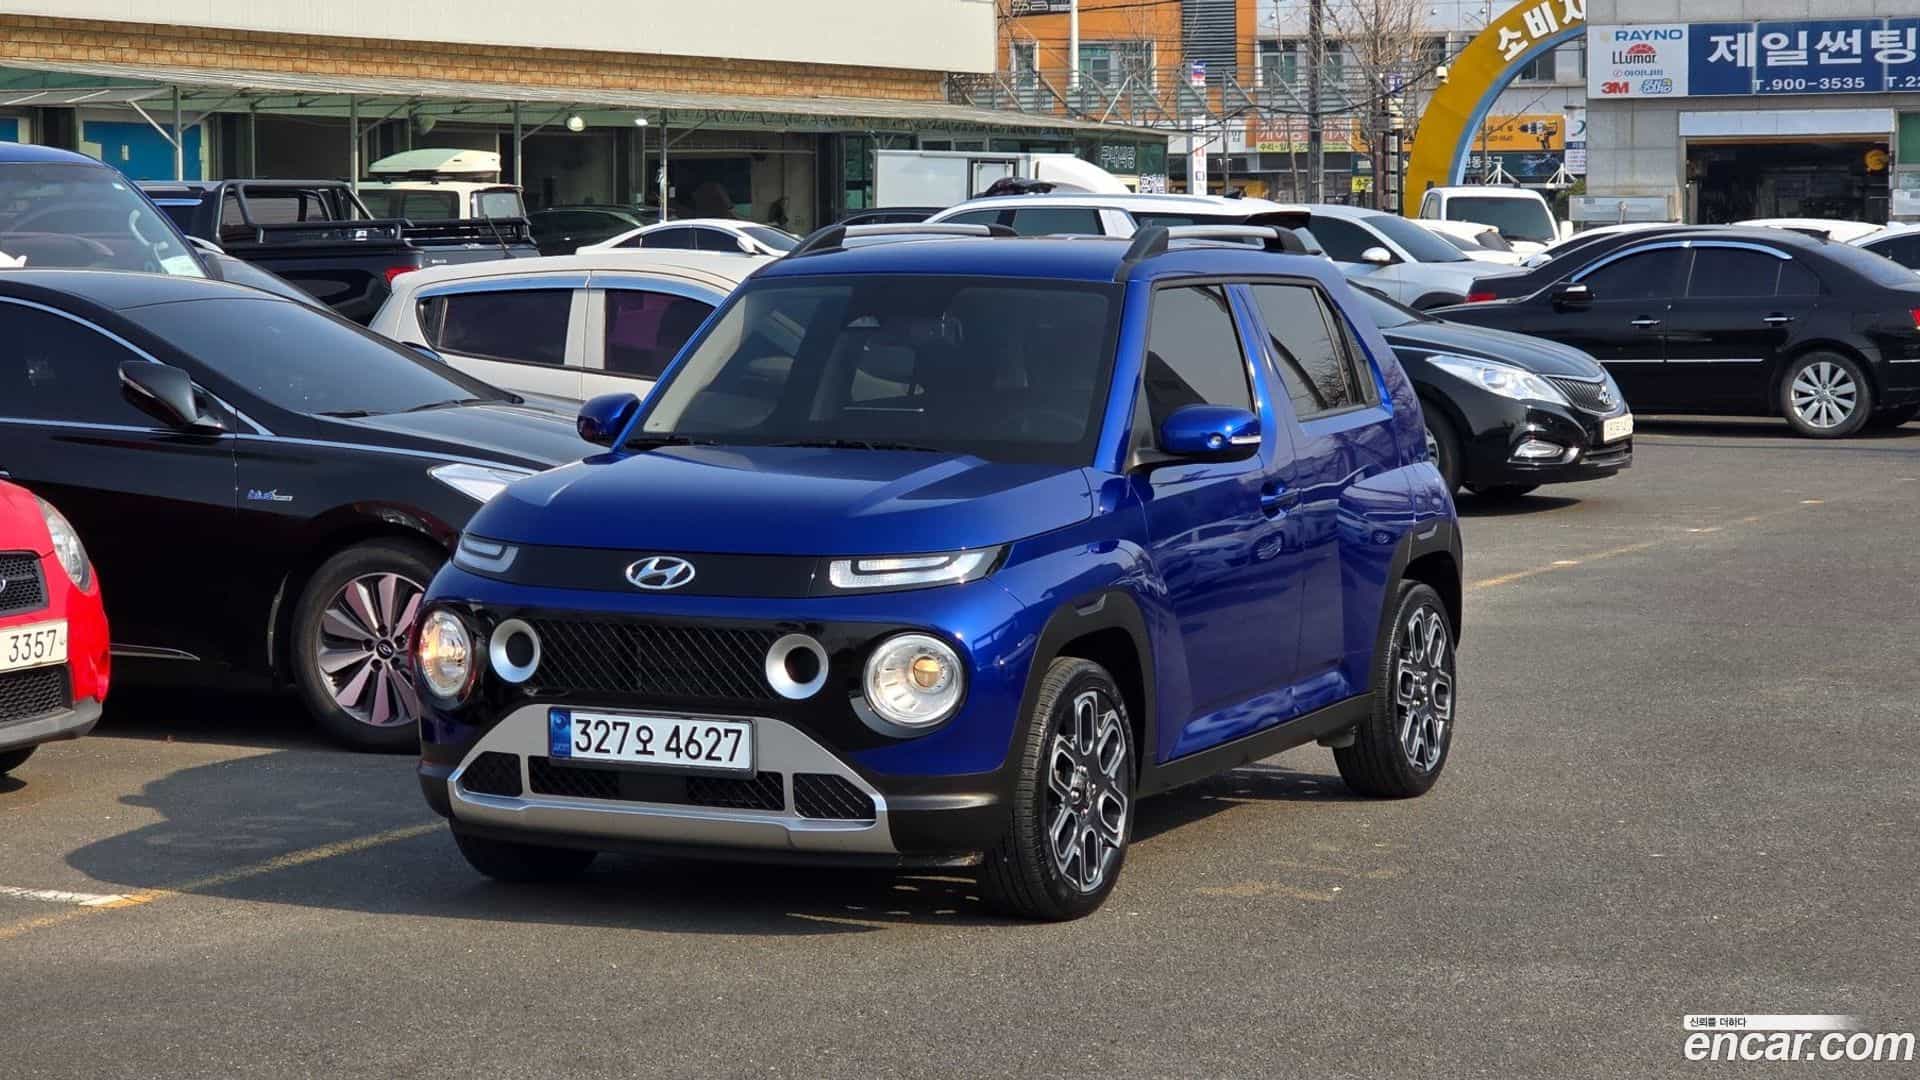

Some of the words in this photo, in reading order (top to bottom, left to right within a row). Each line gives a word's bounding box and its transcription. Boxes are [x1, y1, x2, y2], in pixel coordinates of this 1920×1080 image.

[1615, 29, 1683, 41] RAYNO
[1707, 28, 1917, 67] 제일썬팅
[1612, 50, 1656, 65] LLumar
[1600, 81, 1629, 95] 3M
[1752, 77, 1865, 91] T.900-3535
[9, 629, 57, 663] 3357
[575, 719, 655, 755] 327오
[664, 725, 742, 762] 4627
